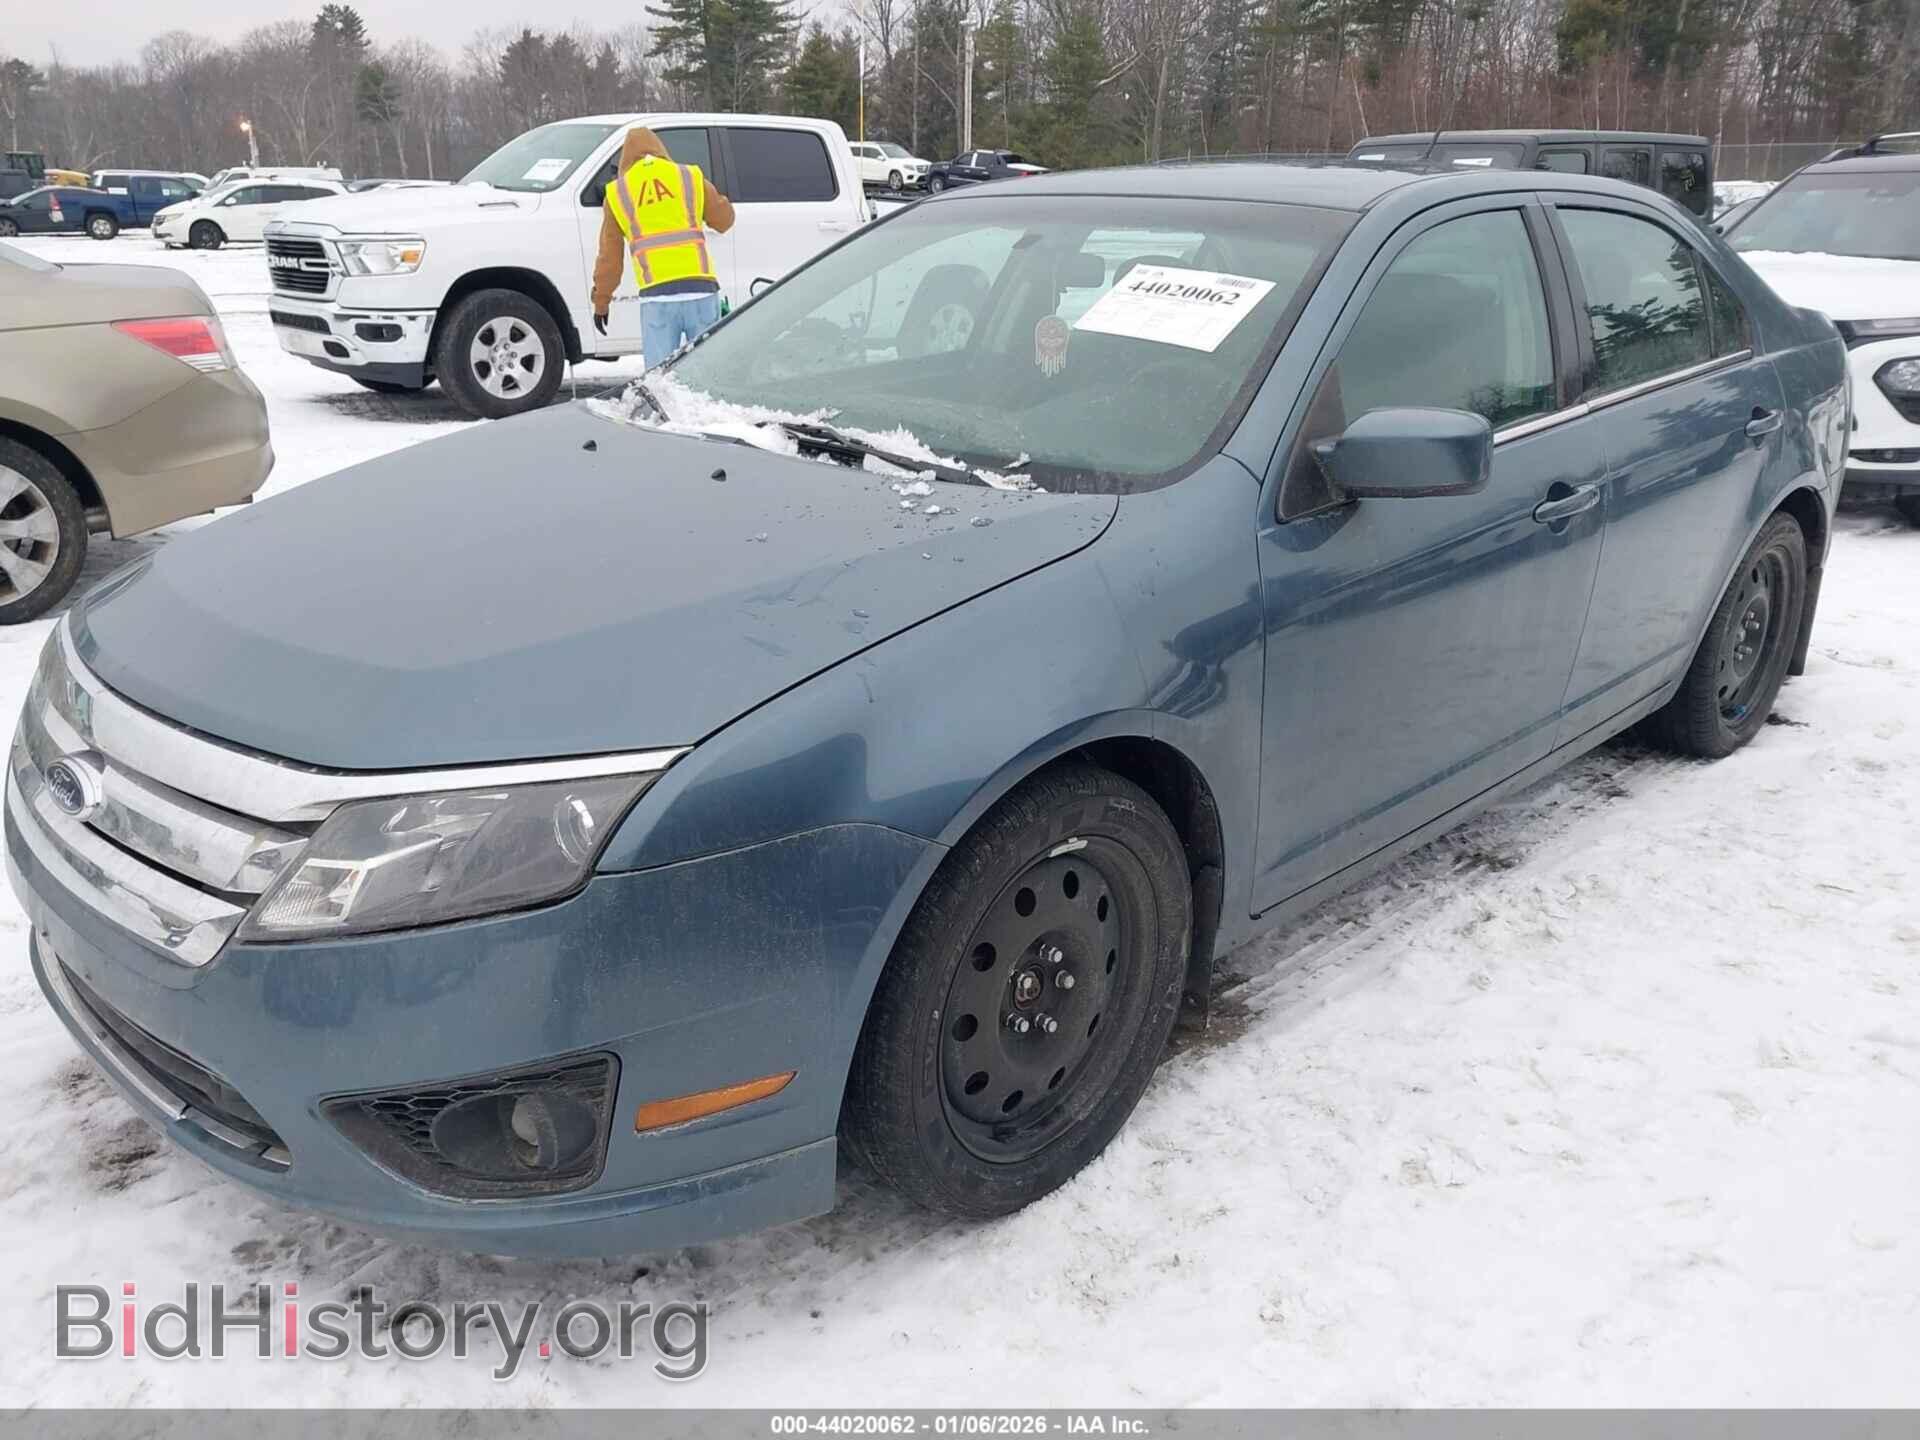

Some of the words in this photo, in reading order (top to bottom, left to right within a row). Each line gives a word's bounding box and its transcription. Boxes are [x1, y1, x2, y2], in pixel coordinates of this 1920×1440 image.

[272, 255, 299, 269] RAM
[1128, 281, 1241, 305] 44020062
[49, 768, 77, 807] Ford
